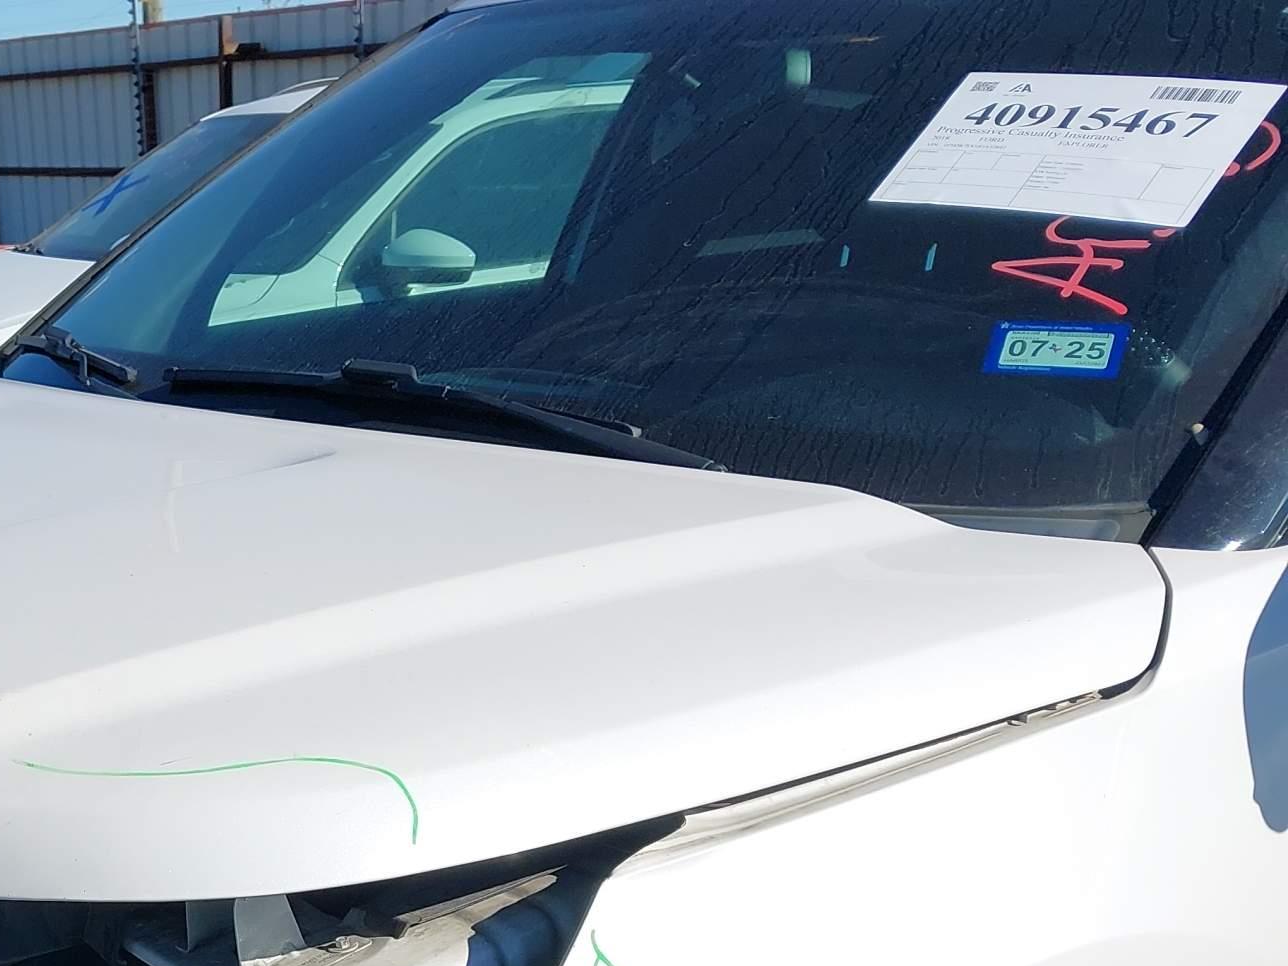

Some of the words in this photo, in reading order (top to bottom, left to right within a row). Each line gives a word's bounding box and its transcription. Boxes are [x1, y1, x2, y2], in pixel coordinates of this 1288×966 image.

[964, 102, 1220, 138] 40915467
[937, 126, 1006, 136] Progressive
[1008, 128, 1060, 139] Casualty
[1063, 130, 1126, 142] Insurance
[1008, 339, 1049, 357] 07
[1063, 340, 1107, 360] 25
